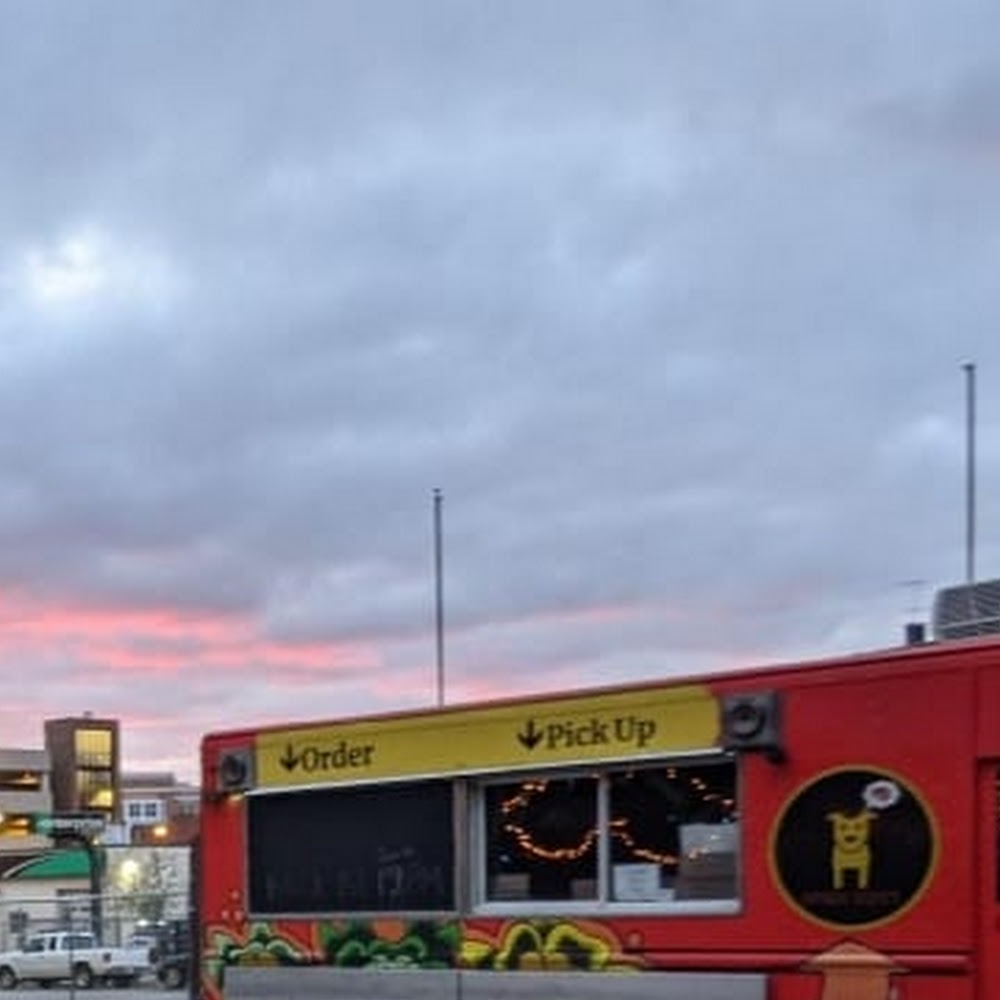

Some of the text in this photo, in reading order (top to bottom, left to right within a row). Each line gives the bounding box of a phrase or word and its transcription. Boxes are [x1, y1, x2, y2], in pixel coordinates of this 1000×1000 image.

[547, 717, 656, 749] Pick Up
[301, 741, 375, 771] Order
